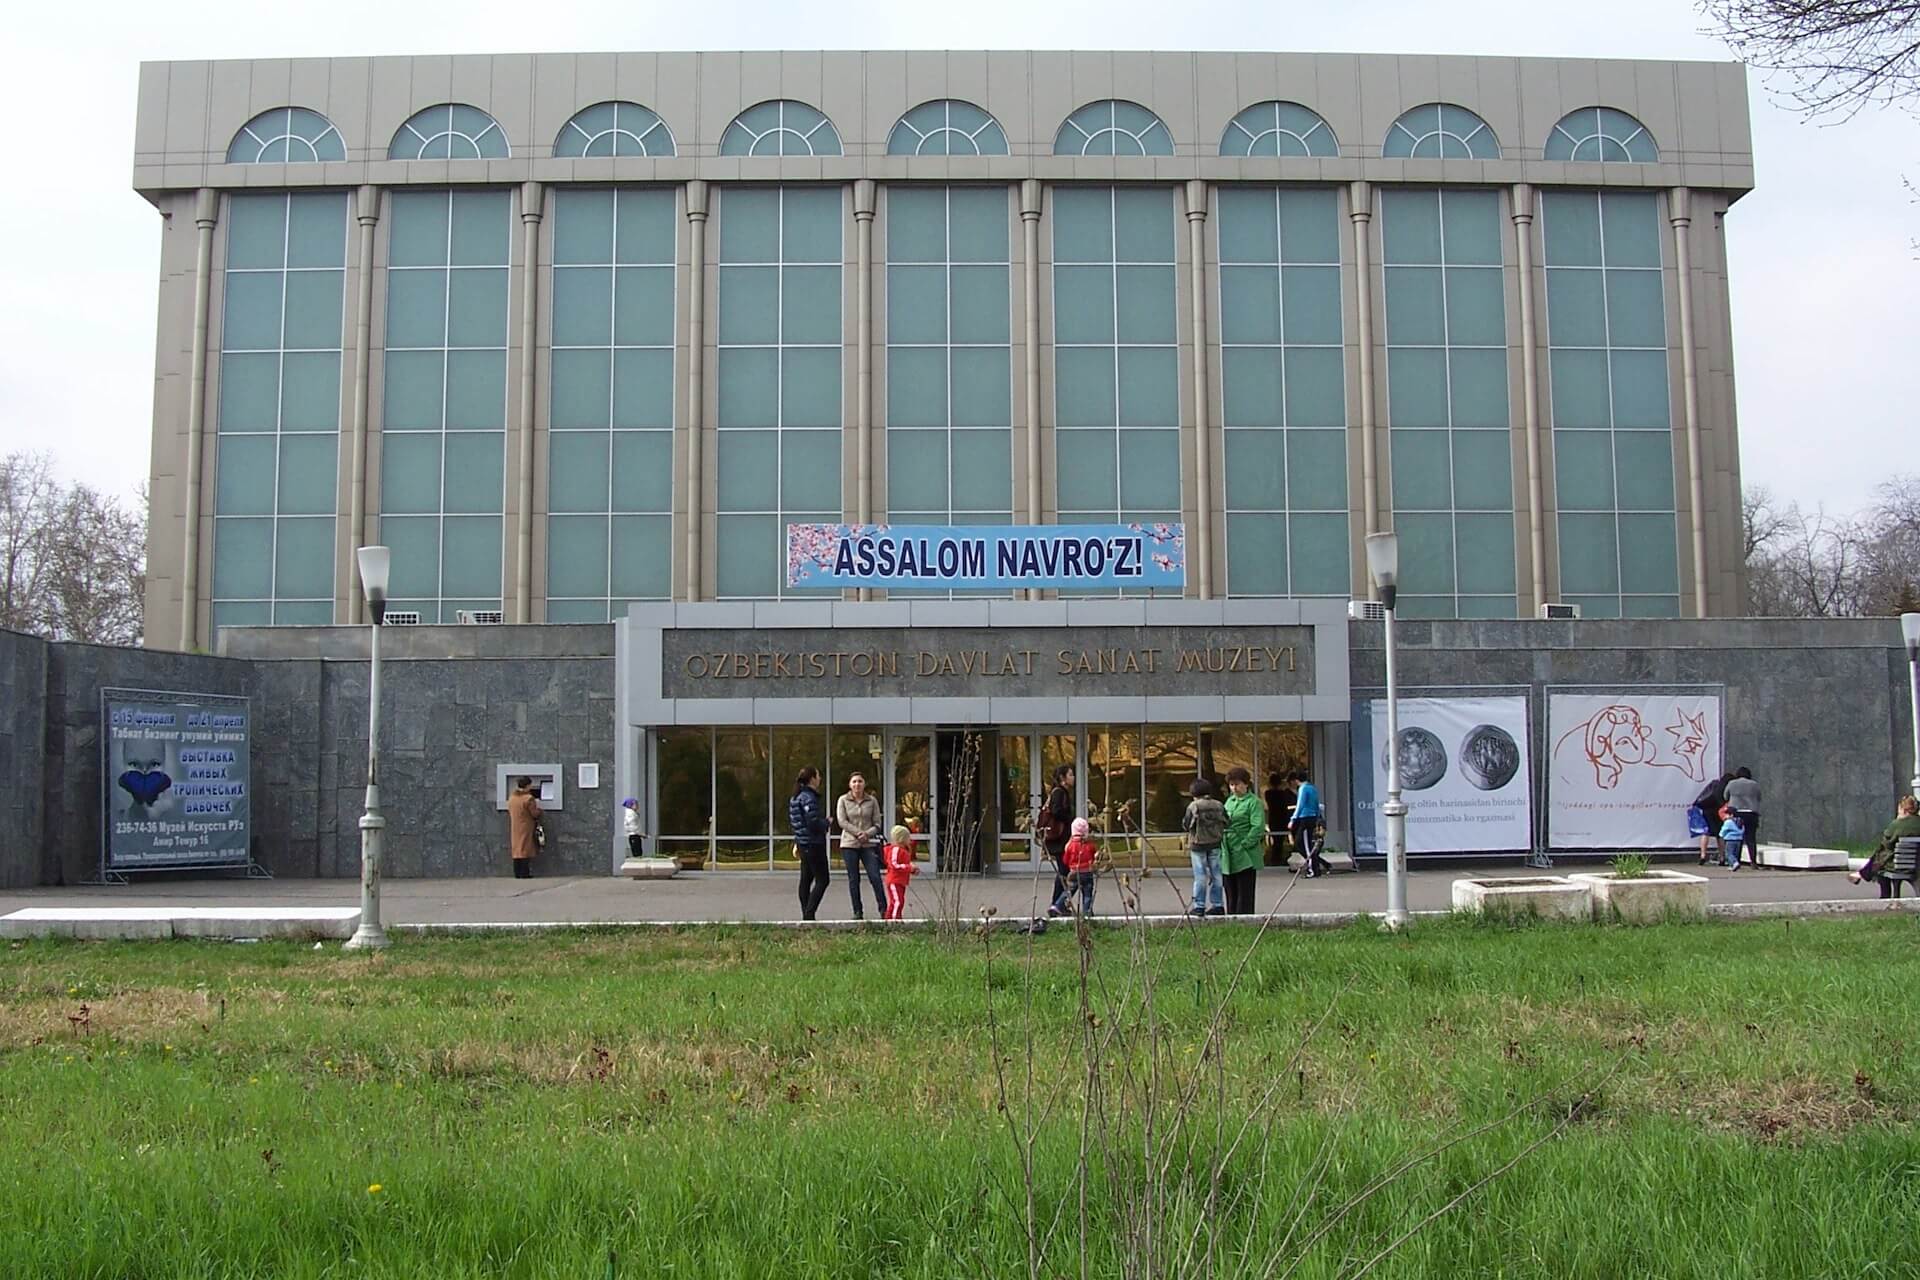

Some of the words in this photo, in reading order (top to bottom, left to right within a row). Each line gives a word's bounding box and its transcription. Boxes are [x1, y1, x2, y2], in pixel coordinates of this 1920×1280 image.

[833, 537, 986, 578] ASSALOM
[686, 651, 899, 678] OZBEKISTON
[916, 650, 1040, 677] DAVLAT
[1057, 649, 1161, 675] SANAT
[1175, 647, 1296, 673] MUZEYI
[135, 711, 175, 728] февраля
[213, 715, 244, 729] апреля
[181, 751, 235, 763] ВЫСТАВКА
[189, 767, 227, 779] ЖИВЫХ
[173, 783, 244, 796] ТРОПИЧЕСКИХ
[185, 800, 232, 813] БАБОЧЕК
[1417, 800, 1437, 808] oltin
[159, 821, 186, 835] Музей
[187, 821, 226, 834] Искусств
[153, 836, 173, 848] Амир
[174, 835, 198, 848] Темур
